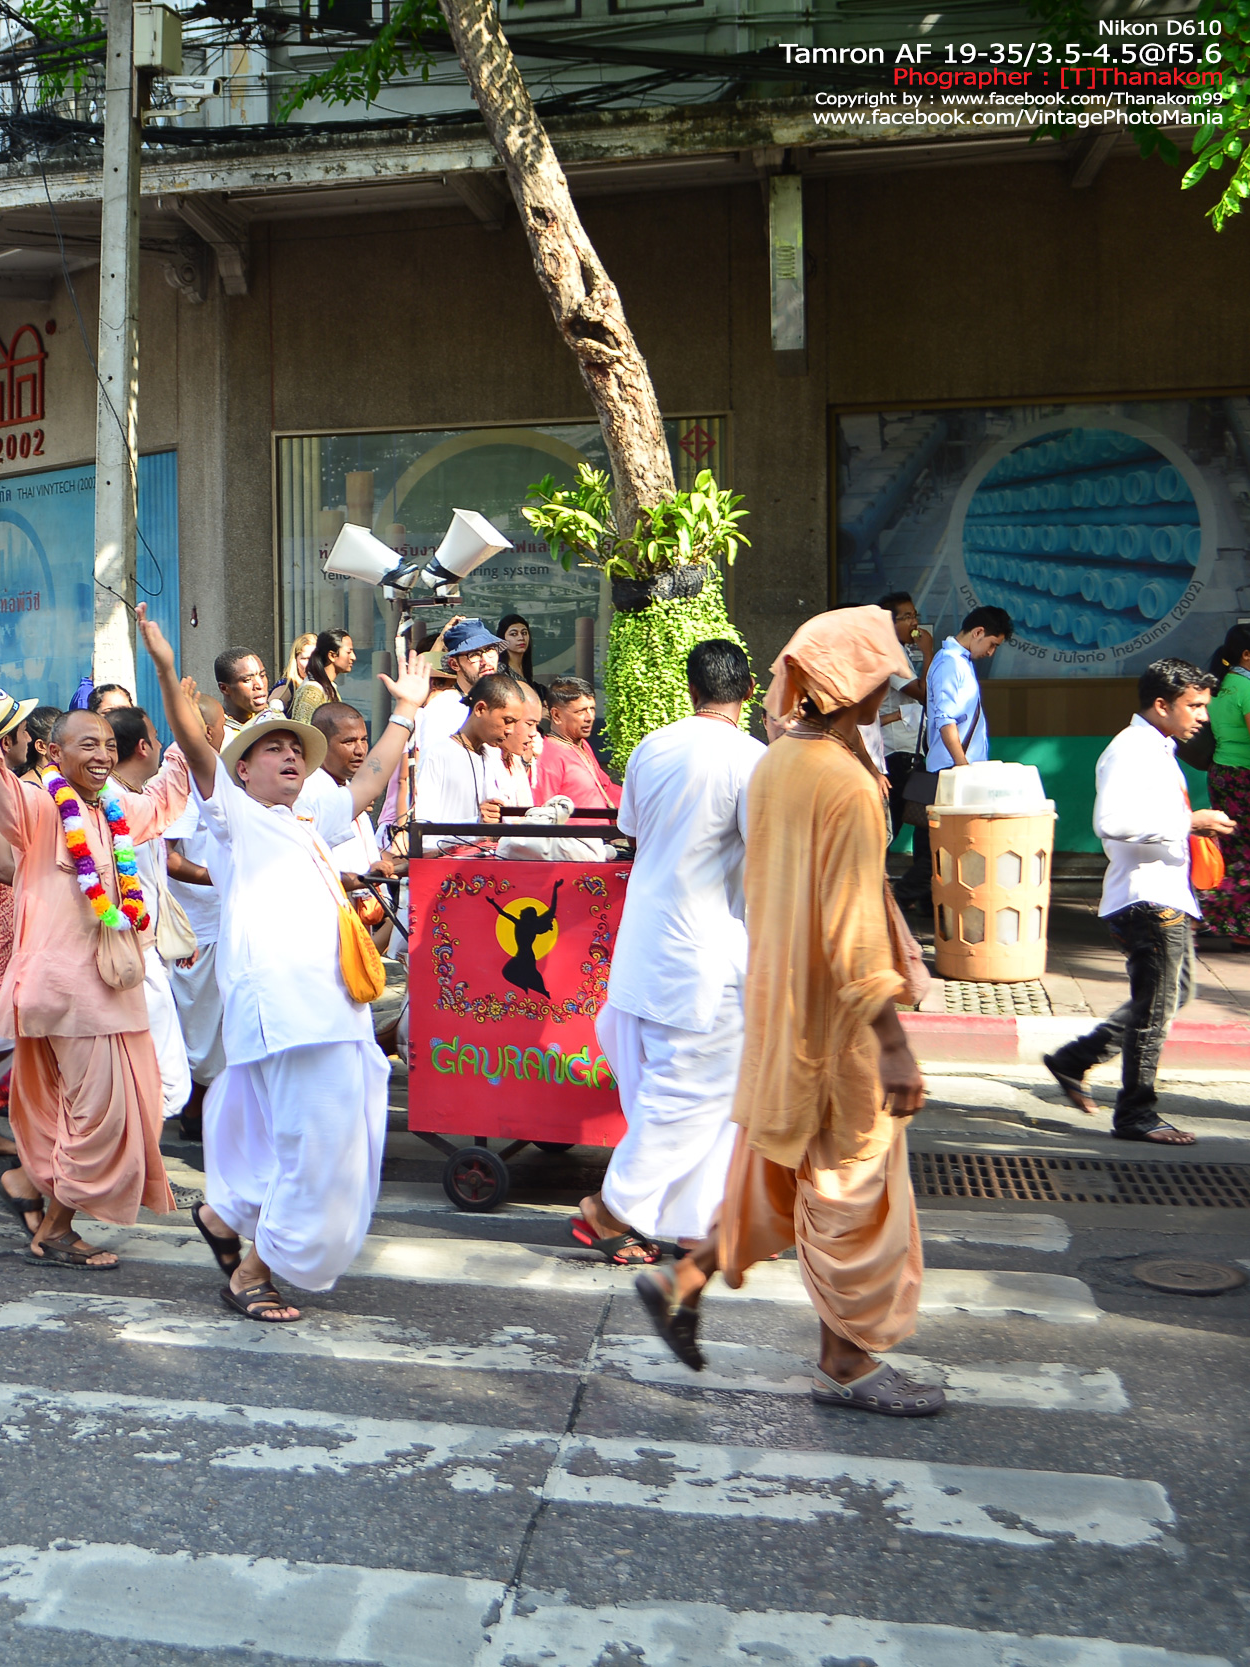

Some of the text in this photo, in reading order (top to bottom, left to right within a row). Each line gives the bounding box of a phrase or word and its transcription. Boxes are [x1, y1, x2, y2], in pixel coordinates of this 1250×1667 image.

[17, 487, 36, 500] THAI
[36, 480, 76, 498] VINYTECH
[503, 566, 549, 579] system
[1171, 580, 1205, 622] (2002)
[431, 1035, 618, 1090] GAURANGA
